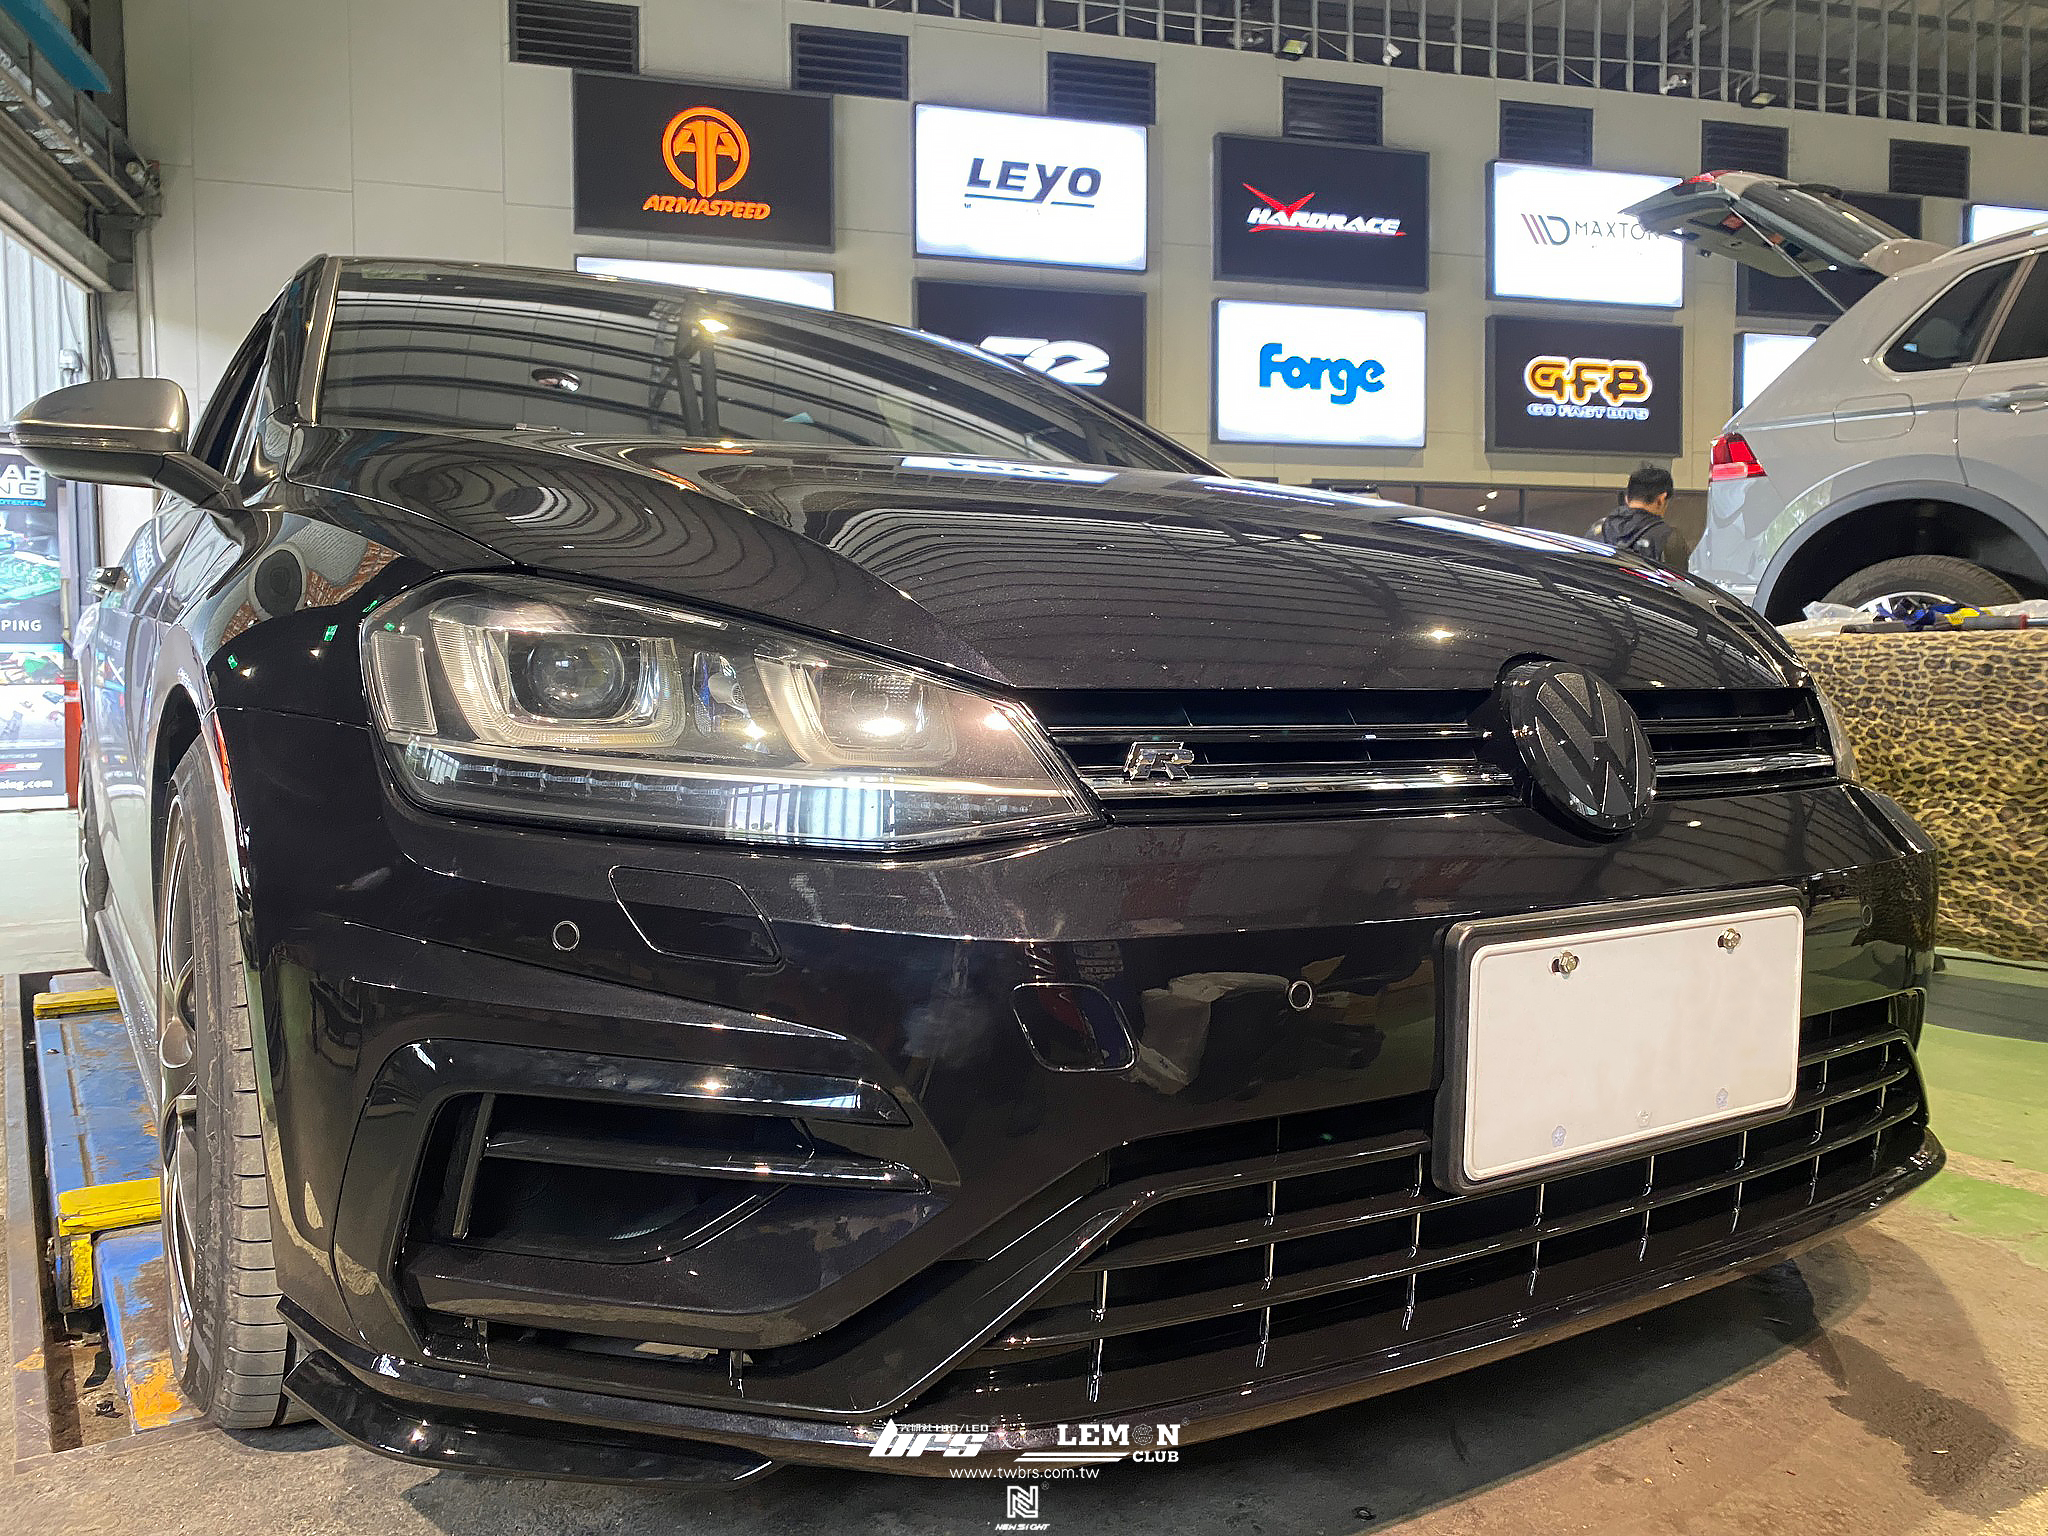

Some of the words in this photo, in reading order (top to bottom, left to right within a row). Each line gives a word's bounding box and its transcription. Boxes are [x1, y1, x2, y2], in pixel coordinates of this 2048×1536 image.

[966, 157, 1102, 204] LEYO
[642, 195, 771, 219] ARMASPEED
[1246, 207, 1401, 236] HARDRACE
[1525, 355, 1653, 406] GFB
[1526, 403, 1557, 416] GO
[1557, 405, 1606, 419] FAST
[1606, 406, 1650, 420] BITS
